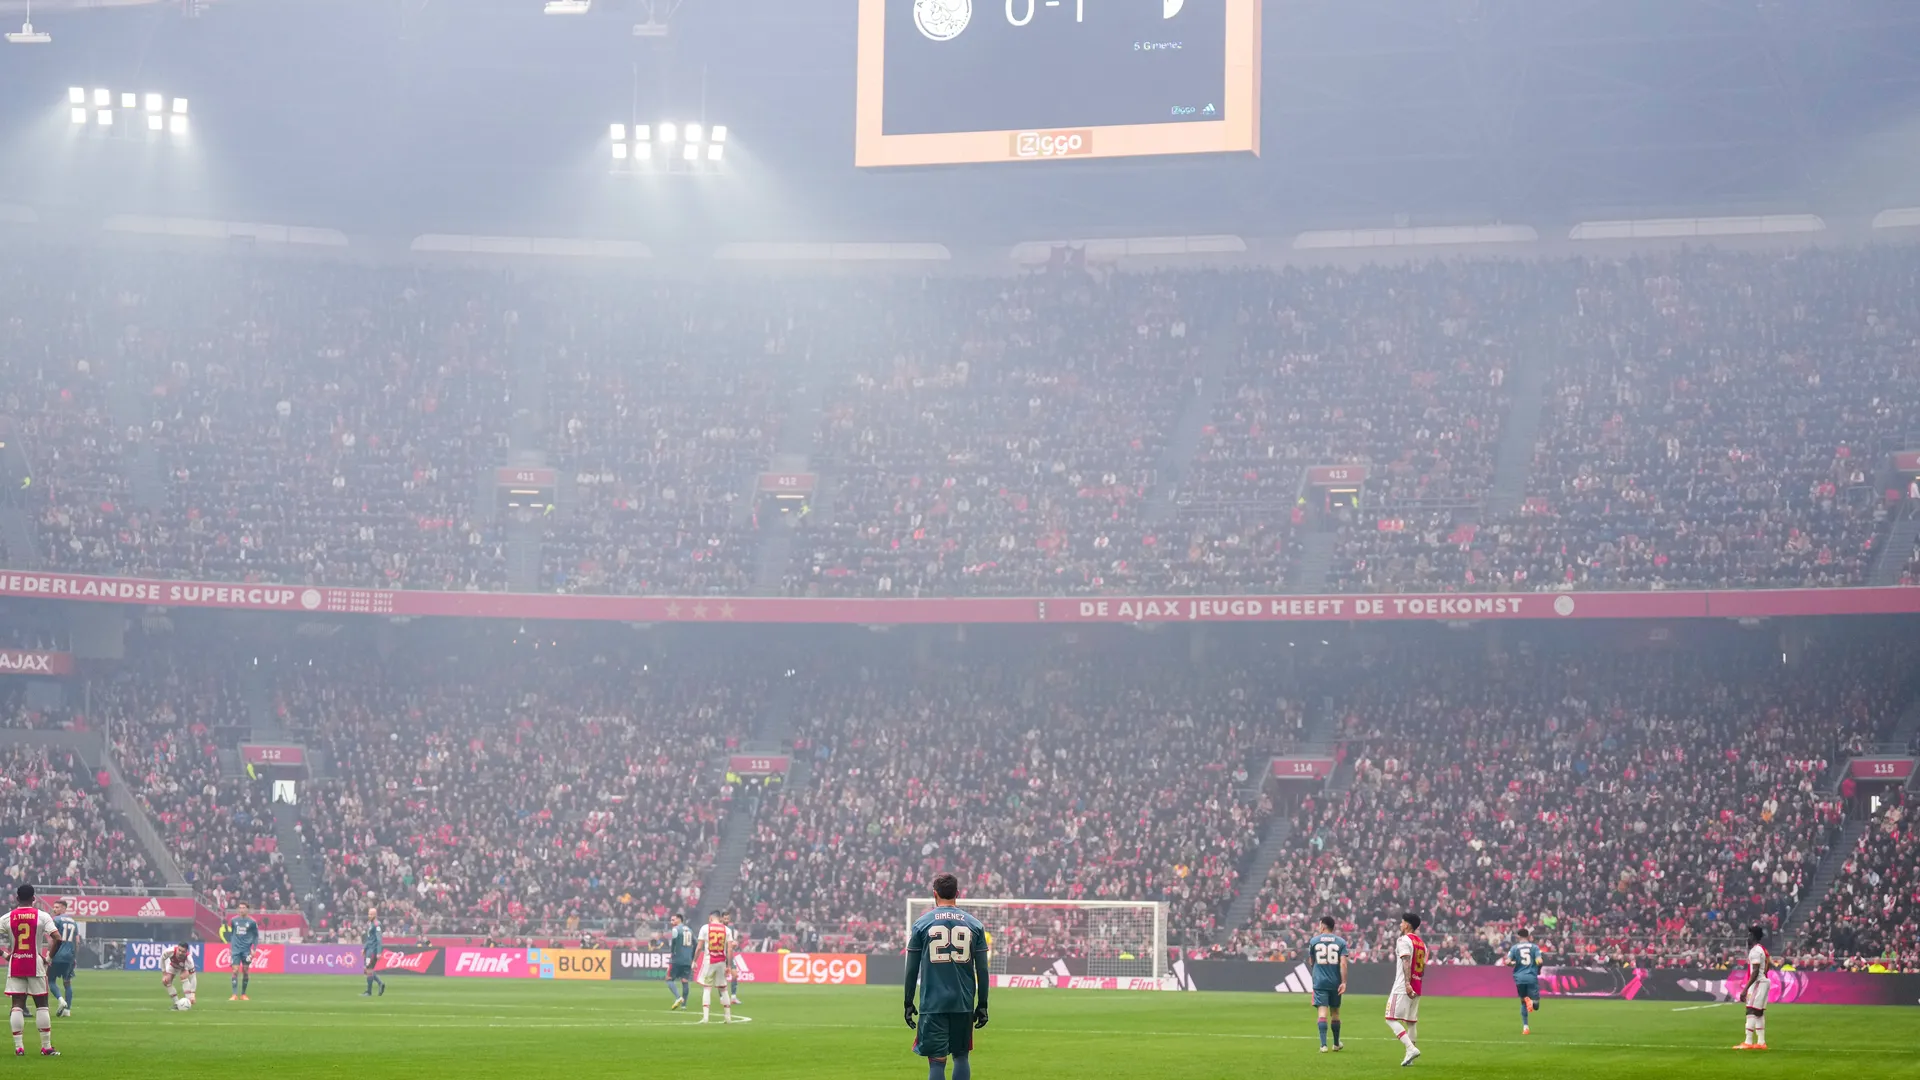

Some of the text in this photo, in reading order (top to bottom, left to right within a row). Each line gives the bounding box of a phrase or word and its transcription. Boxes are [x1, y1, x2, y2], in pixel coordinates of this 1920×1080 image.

[516, 472, 534, 482] 411
[778, 477, 797, 486] 412
[1329, 470, 1348, 479] 413
[170, 585, 295, 605] SUPERCUP
[1080, 598, 1523, 620] DE AJAX JEUGD HEEFT DE TOEKOMST
[0, 653, 49, 671] AJAX
[261, 749, 281, 759] 112
[751, 760, 770, 769] 113
[1293, 763, 1312, 773] 114
[1874, 763, 1895, 774] 115
[18, 923, 31, 951] 2
[62, 923, 76, 943] 17
[682, 931, 693, 947] 10
[709, 931, 725, 951] 23
[928, 925, 972, 964] 29
[384, 951, 422, 968] Bud
[621, 952, 673, 968] UNIBE
[1315, 943, 1340, 965] 26
[1520, 948, 1531, 966] 5
[455, 952, 514, 974] Flink
[558, 956, 608, 972] BLOX
[1008, 976, 1043, 988] Flink
